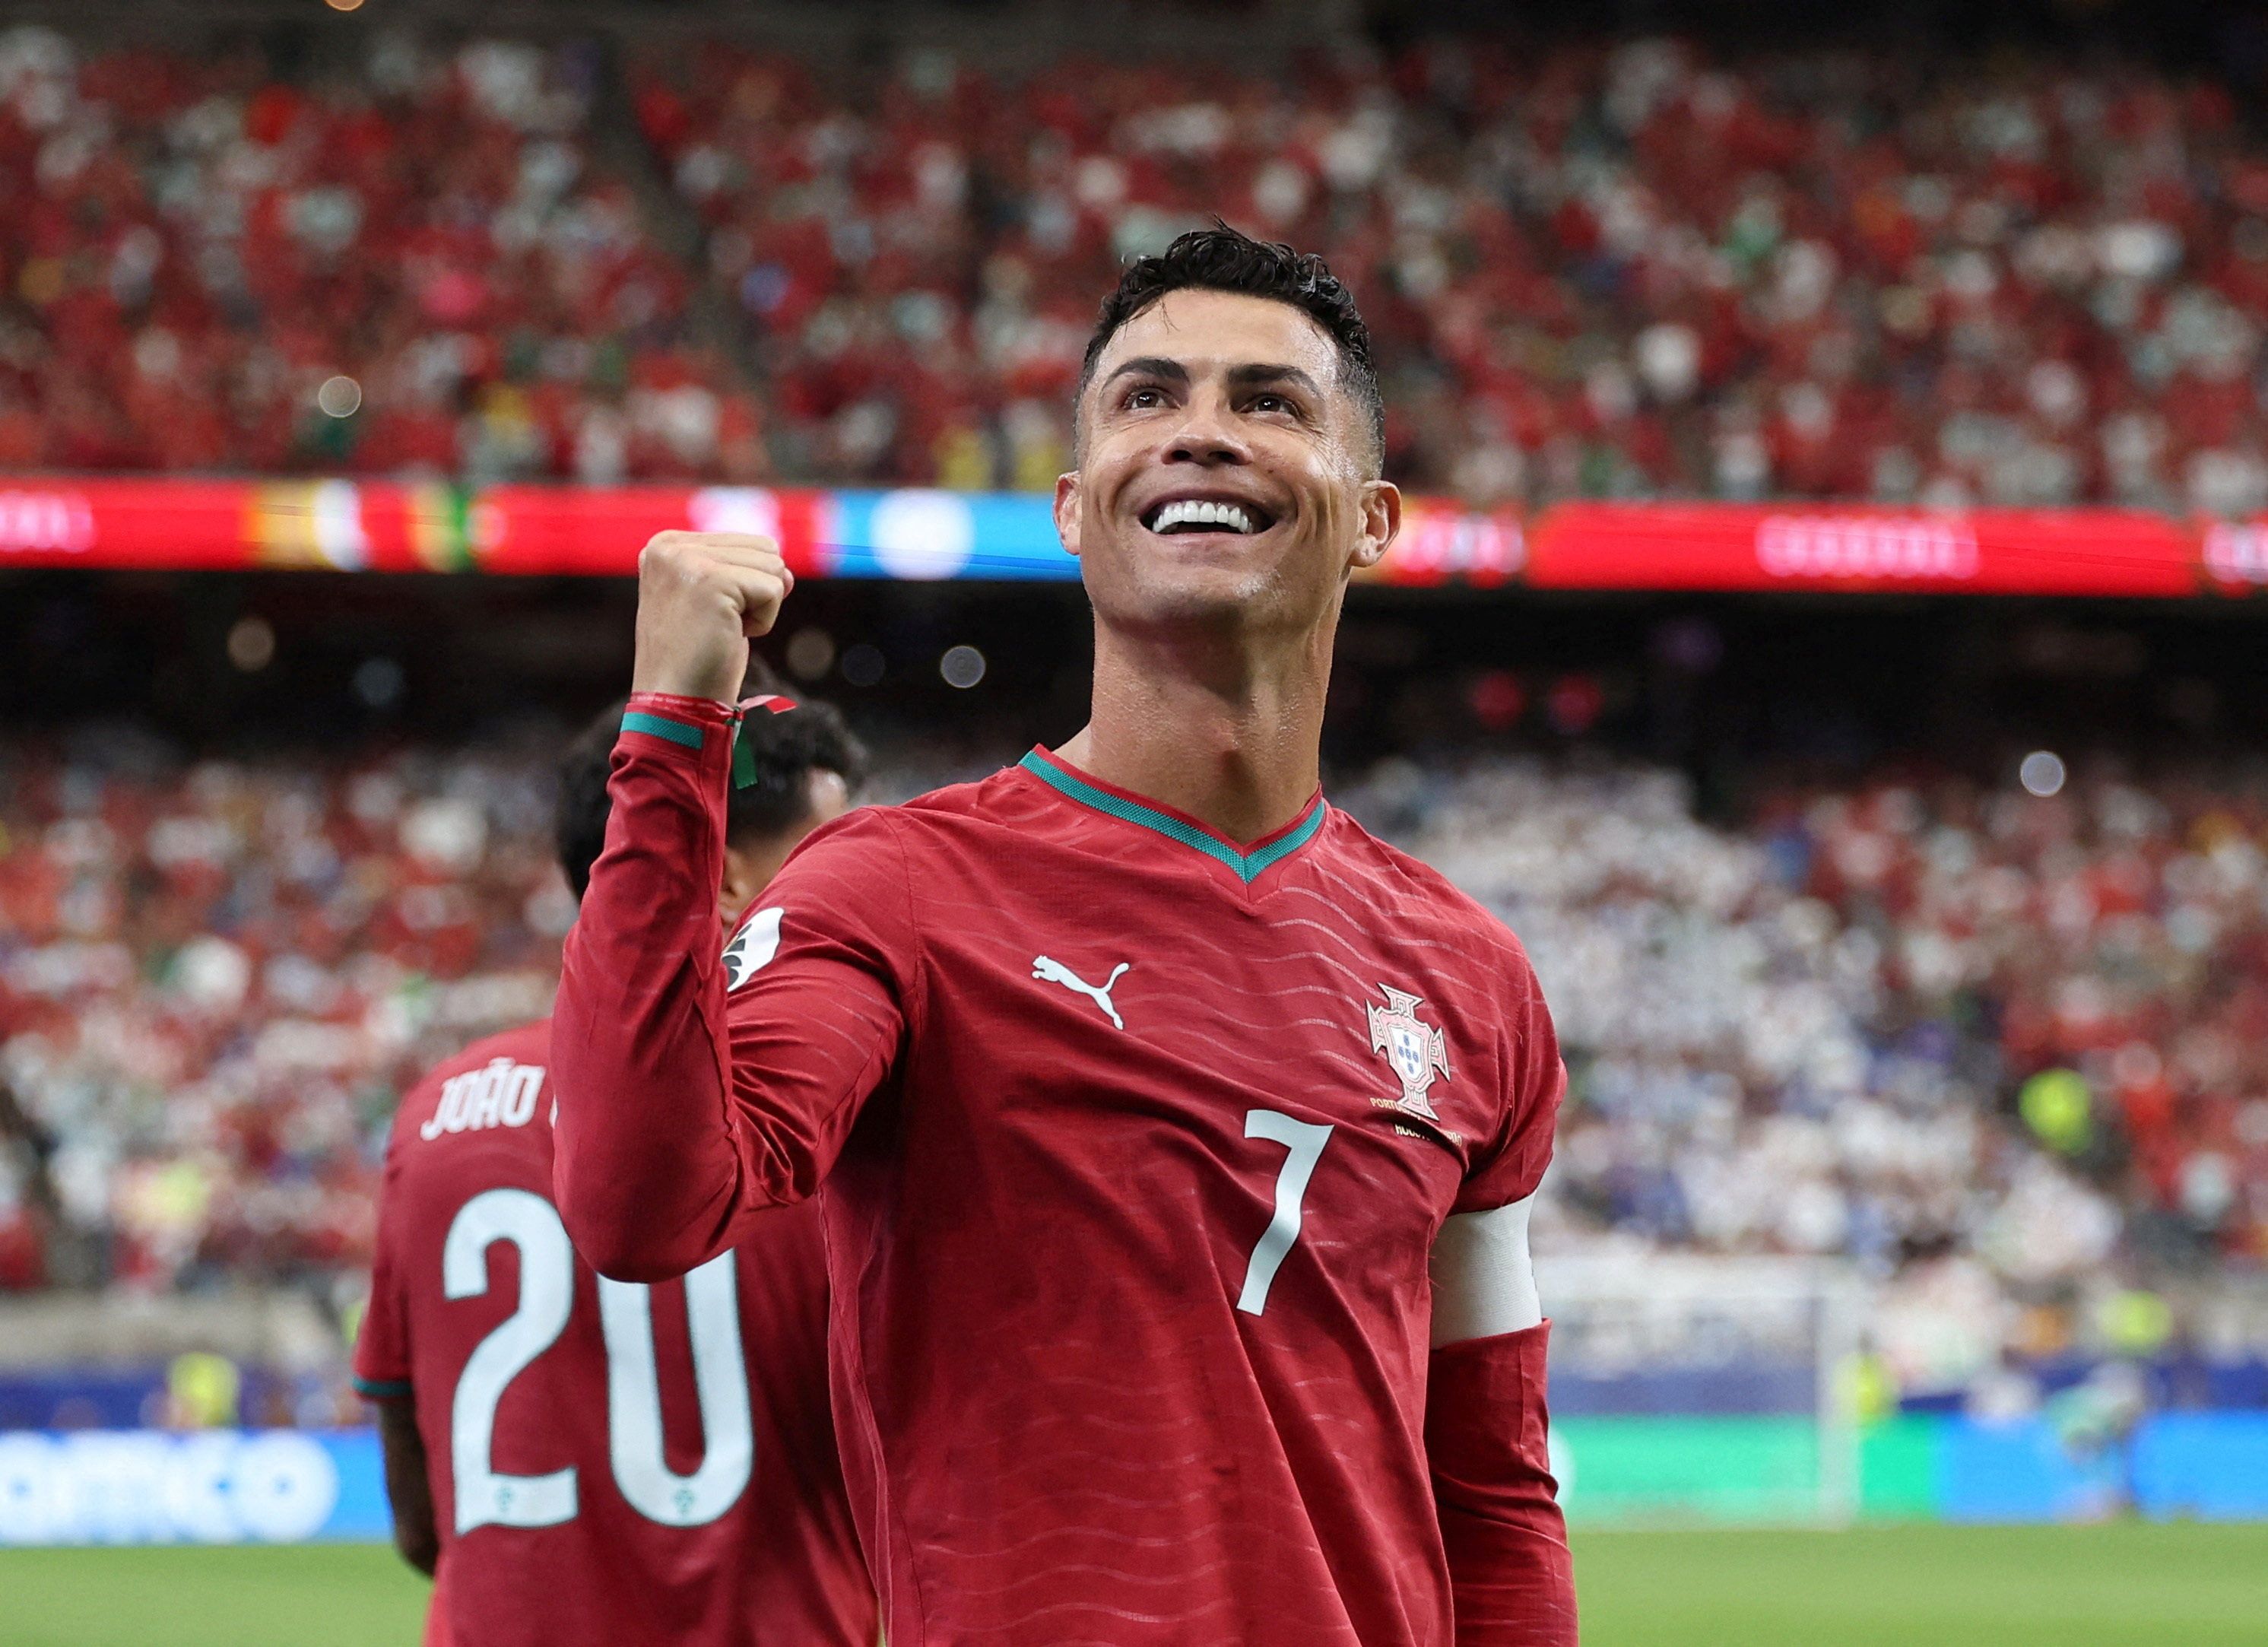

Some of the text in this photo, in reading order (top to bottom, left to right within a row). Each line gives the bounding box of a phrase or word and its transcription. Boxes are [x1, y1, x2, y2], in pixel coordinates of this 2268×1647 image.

[420, 1057, 547, 1141] JOÃO
[1236, 1109, 1335, 1316] 7
[442, 1188, 754, 1536] 20
